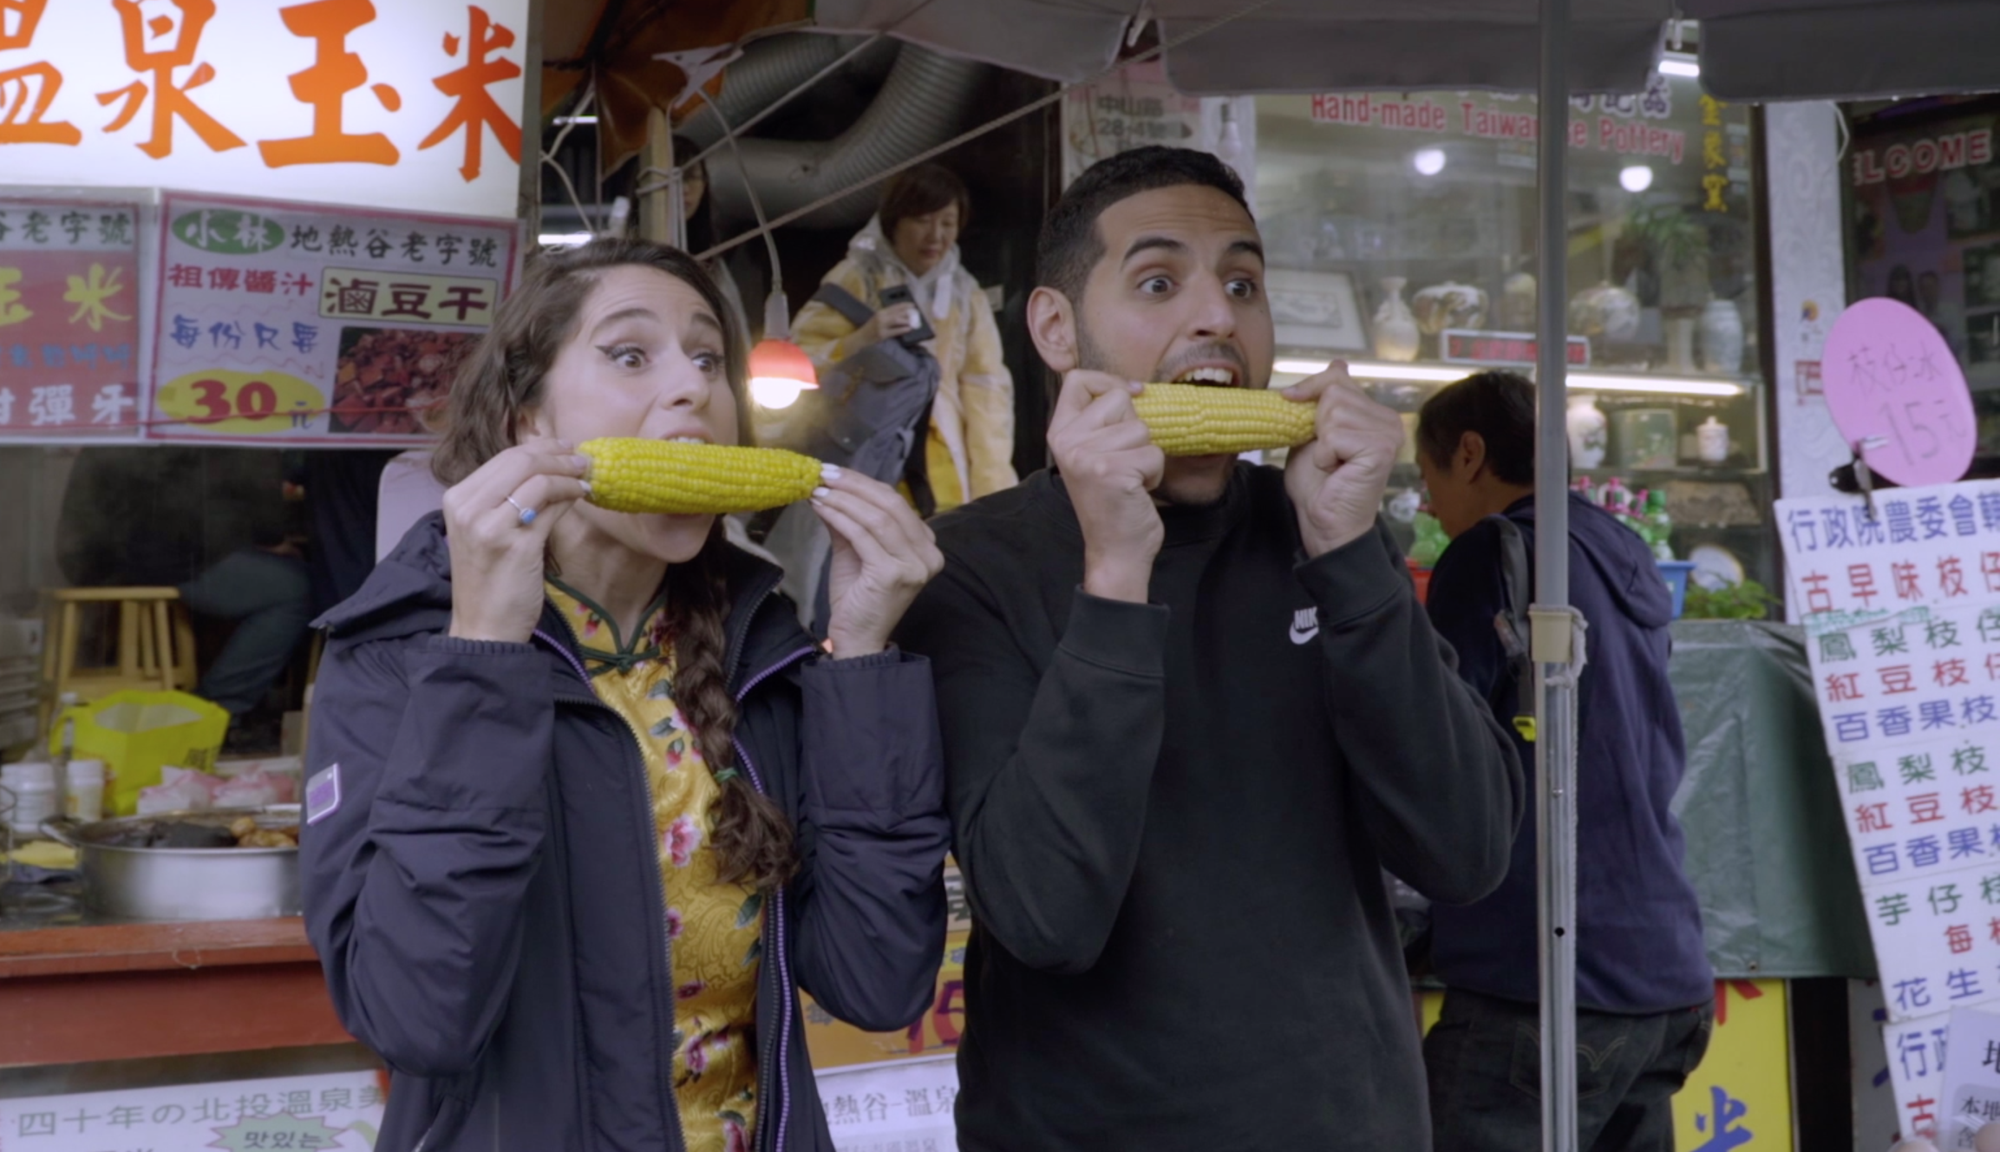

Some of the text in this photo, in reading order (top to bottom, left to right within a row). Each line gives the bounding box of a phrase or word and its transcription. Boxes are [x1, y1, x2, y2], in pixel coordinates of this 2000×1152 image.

[1311, 93, 1446, 131] Hand-made
[1461, 103, 1587, 146] Taiwae
[1600, 119, 1686, 162] Pottery
[290, 225, 498, 268] 地熱谷老字號
[168, 264, 489, 321] 祖傳醬汁 滷豆干
[169, 314, 319, 354] 每份只要
[1294, 605, 1318, 630] NIK
[1831, 694, 1999, 743] 百香果枝
[1847, 745, 1990, 794] 鳳梨枝
[1854, 784, 2000, 834] 紅豆枝
[1892, 964, 2000, 1012] 花生
